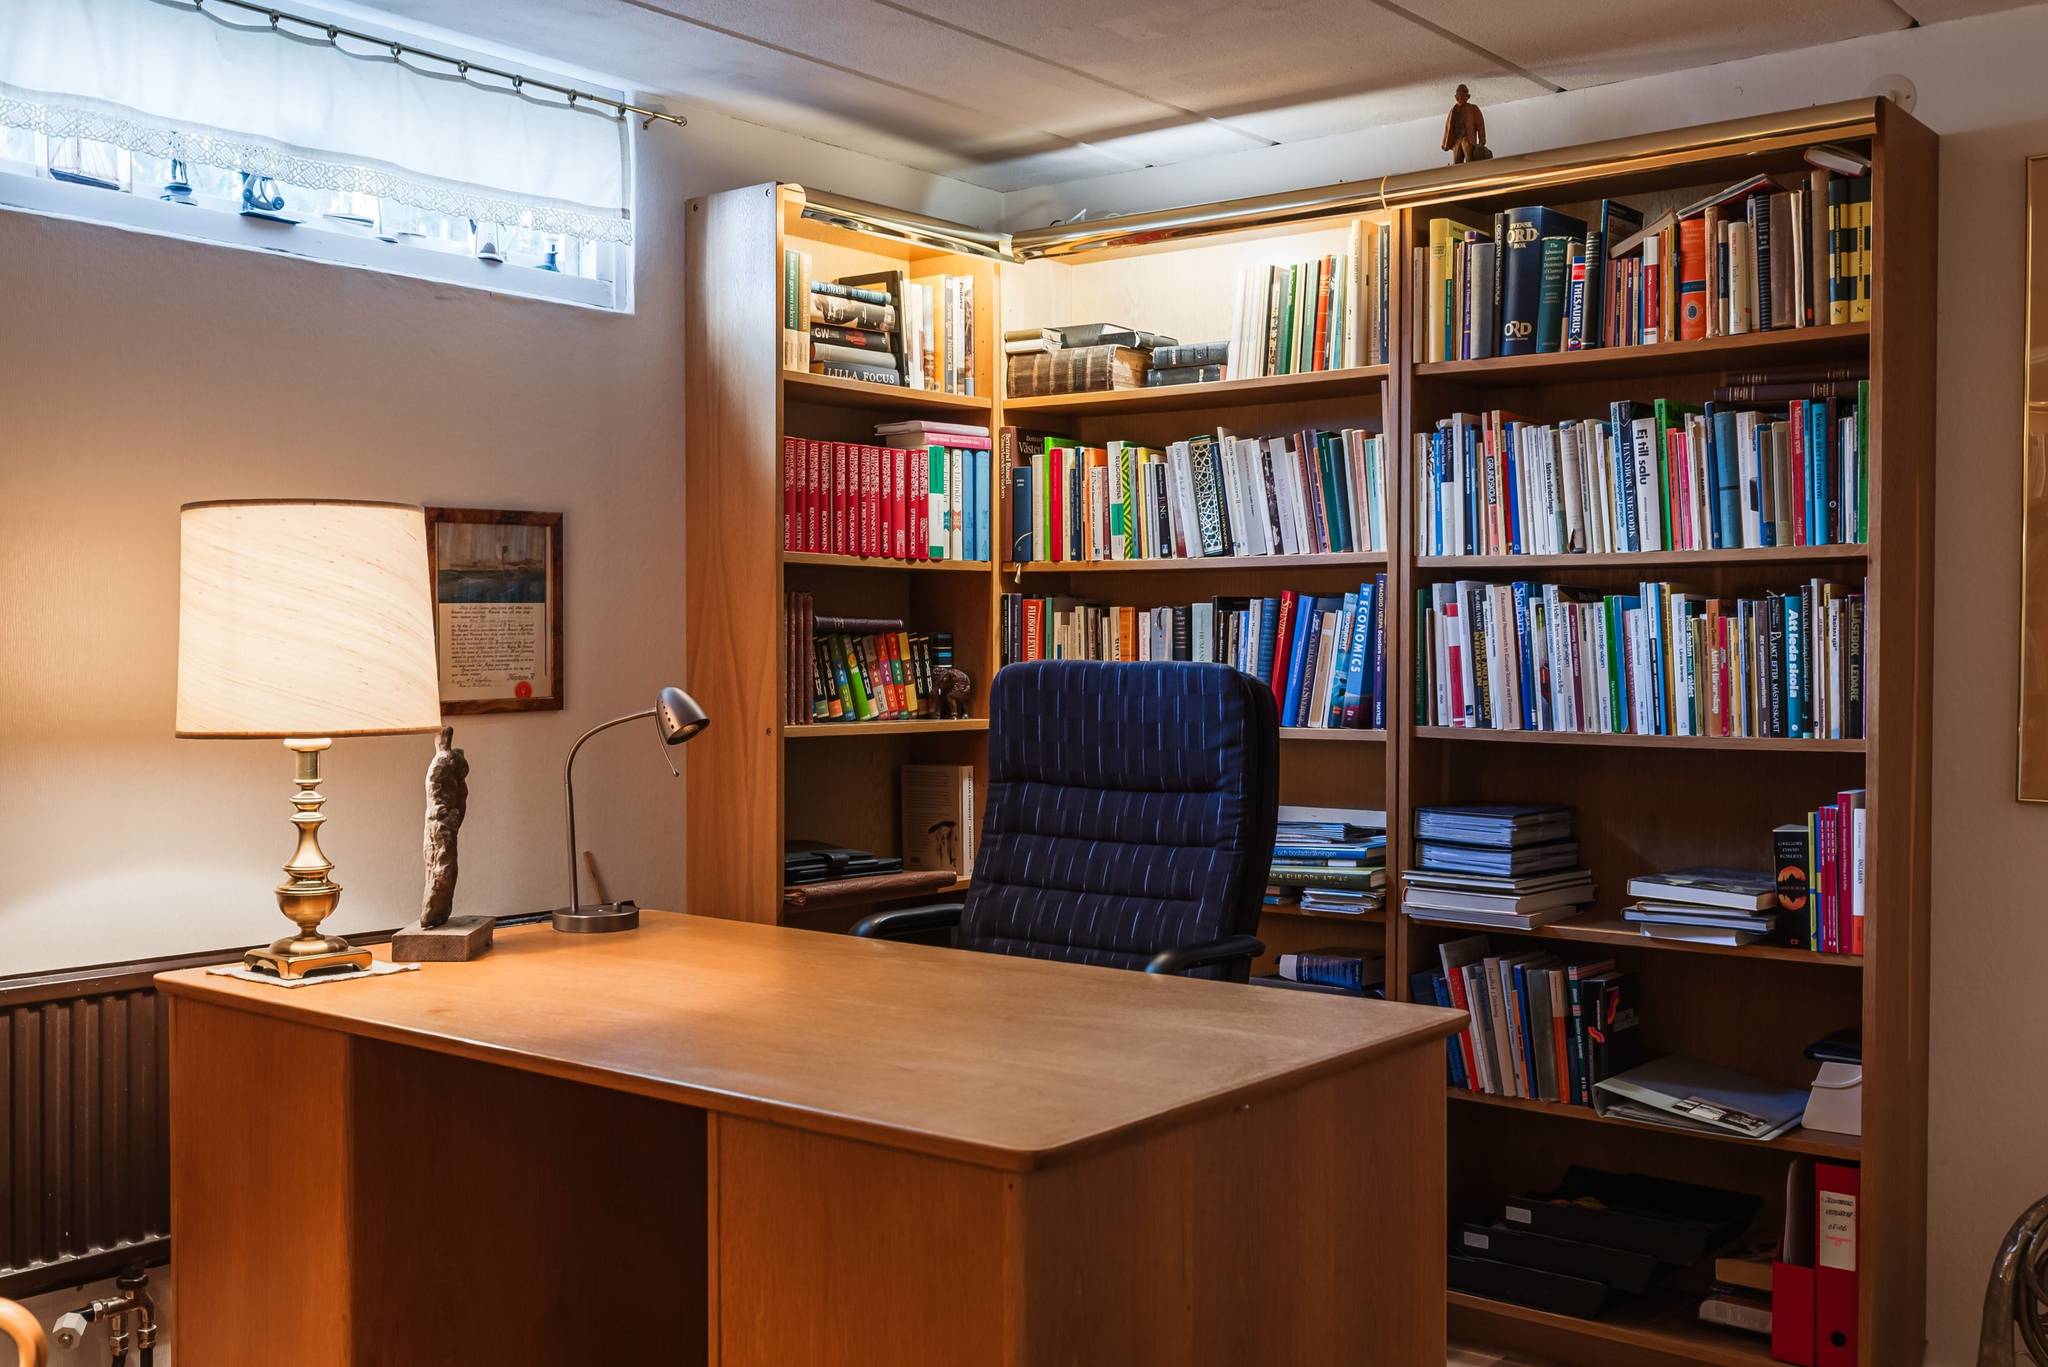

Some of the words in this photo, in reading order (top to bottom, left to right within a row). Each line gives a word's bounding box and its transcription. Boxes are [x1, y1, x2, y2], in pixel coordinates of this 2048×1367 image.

[1507, 228, 1540, 244] ORD
[1572, 283, 1583, 333] THESAURUS
[815, 328, 829, 338] GW
[1505, 321, 1532, 337] ORD
[828, 368, 858, 380] LILLA
[863, 372, 895, 383] FOCUS
[1636, 429, 1648, 439] Ej
[1815, 413, 1823, 439] Boken
[1623, 442, 1632, 488] HANDBOK
[1637, 442, 1649, 456] till
[1487, 458, 1496, 503] GRUNDSKOLA
[1638, 460, 1650, 485] salu
[1816, 463, 1824, 499] centrum
[1158, 496, 1167, 519] JUNG
[1546, 481, 1554, 515] värderingar
[1626, 496, 1635, 538] METODIK
[1278, 599, 1292, 639] SPANIEN
[1515, 588, 1525, 636] Skolbarn
[1788, 609, 1798, 632] Att
[1341, 612, 1352, 651] GEOGRAPHY
[1350, 600, 1368, 673] ECONOMICS
[1789, 634, 1798, 662] leda
[1474, 640, 1482, 686] EDUCATION
[1711, 648, 1719, 672] Aktivt
[1711, 673, 1720, 714] lärarskap
[1790, 663, 1799, 698] skola
[1850, 664, 1859, 701] LEDARE
